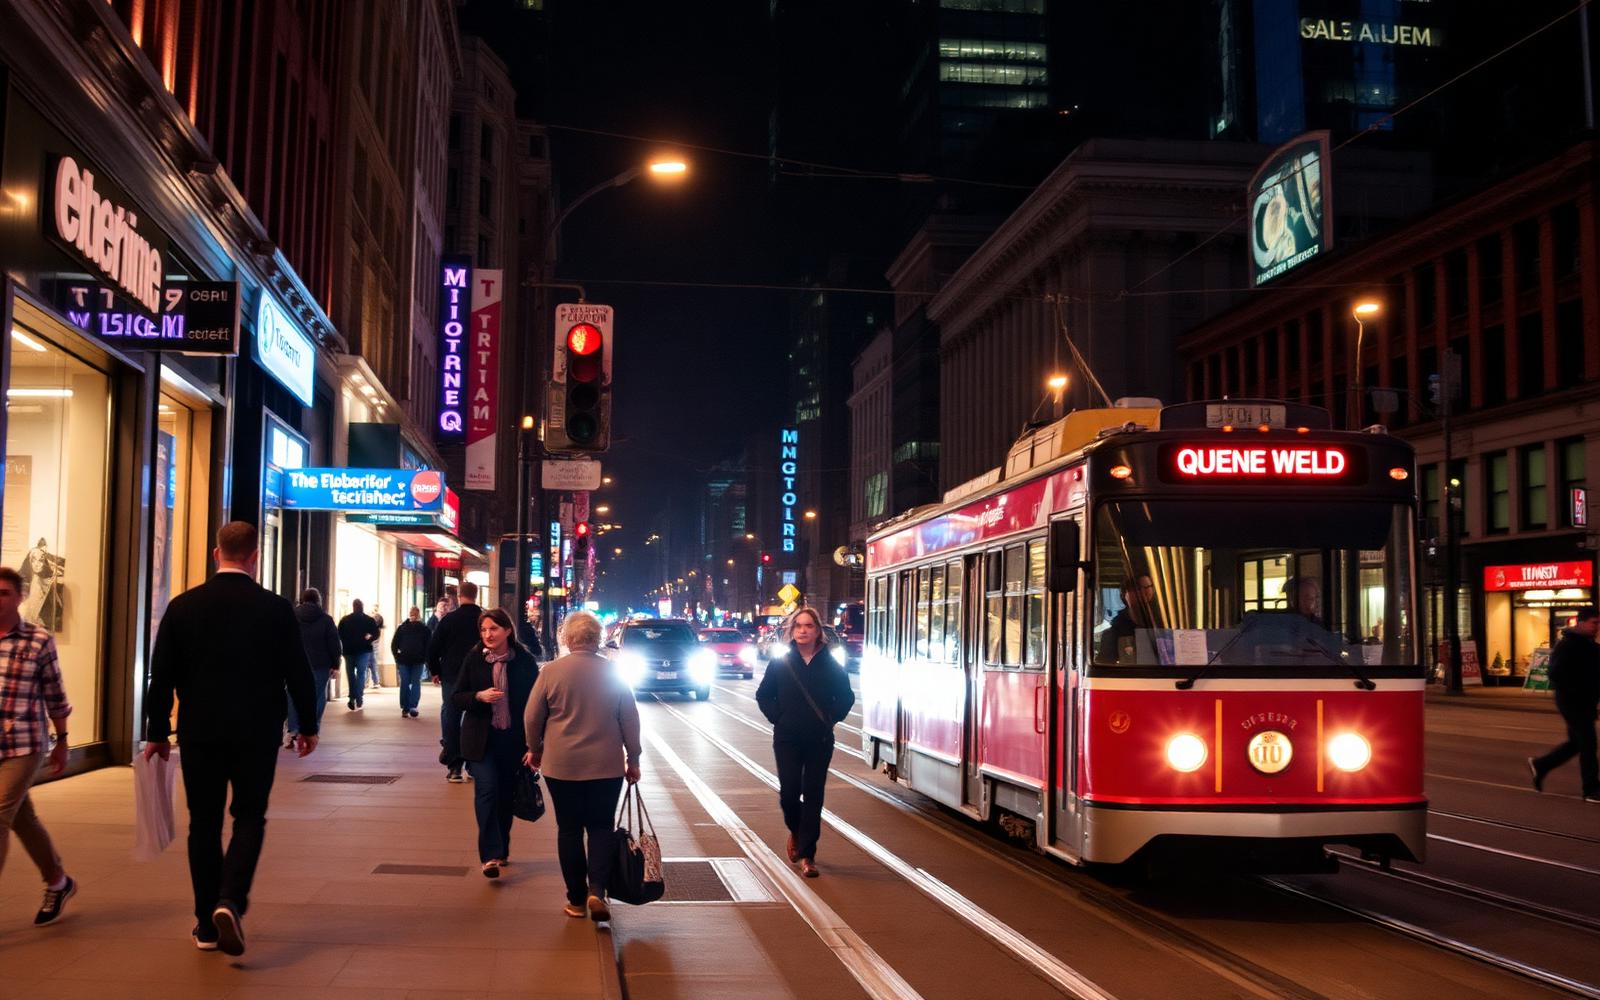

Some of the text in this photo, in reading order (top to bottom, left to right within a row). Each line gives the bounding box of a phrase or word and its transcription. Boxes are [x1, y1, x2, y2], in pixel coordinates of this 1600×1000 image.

[1177, 448, 1345, 476] QUENE WELD
[289, 472, 319, 489] The
